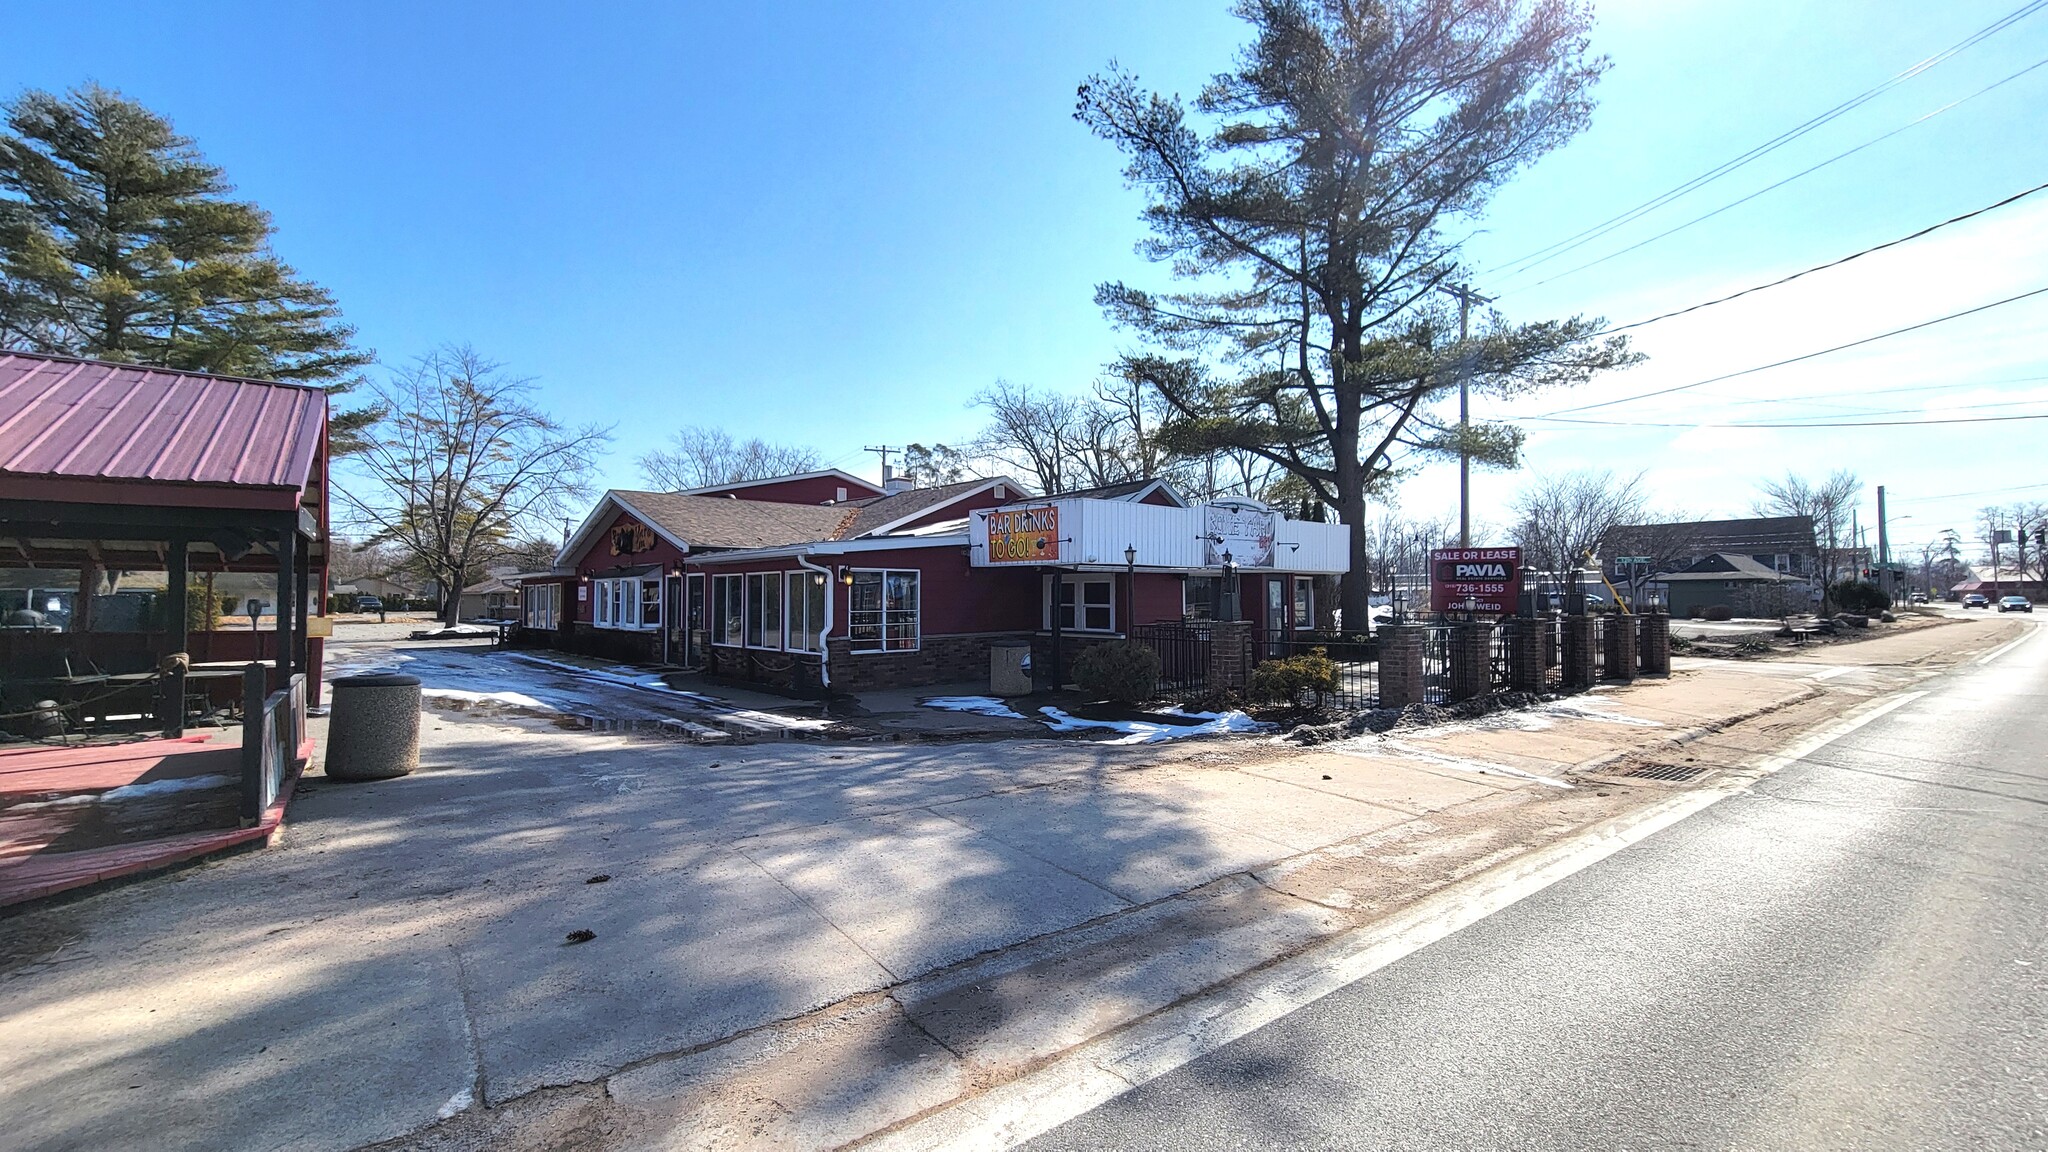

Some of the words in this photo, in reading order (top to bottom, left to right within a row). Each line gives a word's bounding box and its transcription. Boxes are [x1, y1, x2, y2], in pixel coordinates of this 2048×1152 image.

[990, 515, 1011, 535] BAR
[1014, 510, 1055, 533] DRINKS
[990, 539, 1005, 559] TO
[1007, 537, 1029, 558] GO!
[1434, 551, 1460, 561] SALE
[1462, 551, 1478, 560] OR
[1480, 550, 1517, 560] LEASE
[1456, 564, 1506, 577] PAVIA
[1456, 583, 1504, 593] 736-1555
